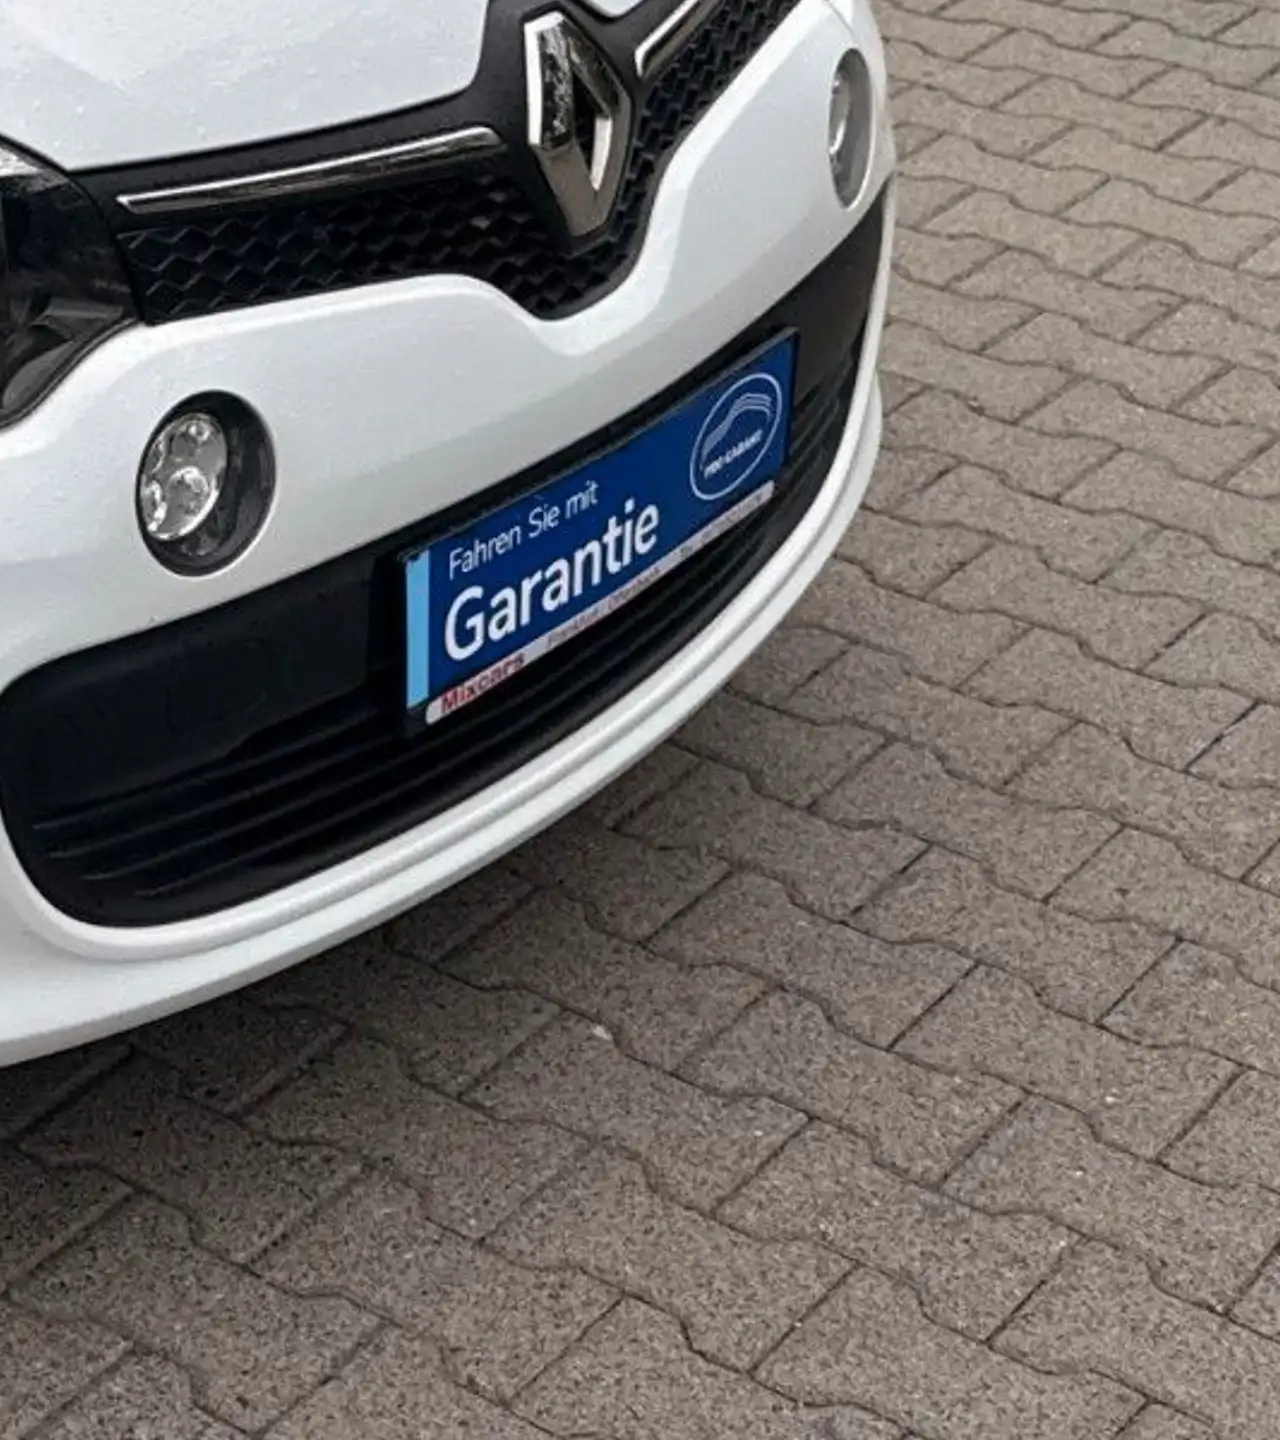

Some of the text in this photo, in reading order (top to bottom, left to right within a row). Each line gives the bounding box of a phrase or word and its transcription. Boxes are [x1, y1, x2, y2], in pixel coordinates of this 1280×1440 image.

[444, 497, 660, 661] Garantie
[449, 479, 600, 581] Fahren Sie mit
